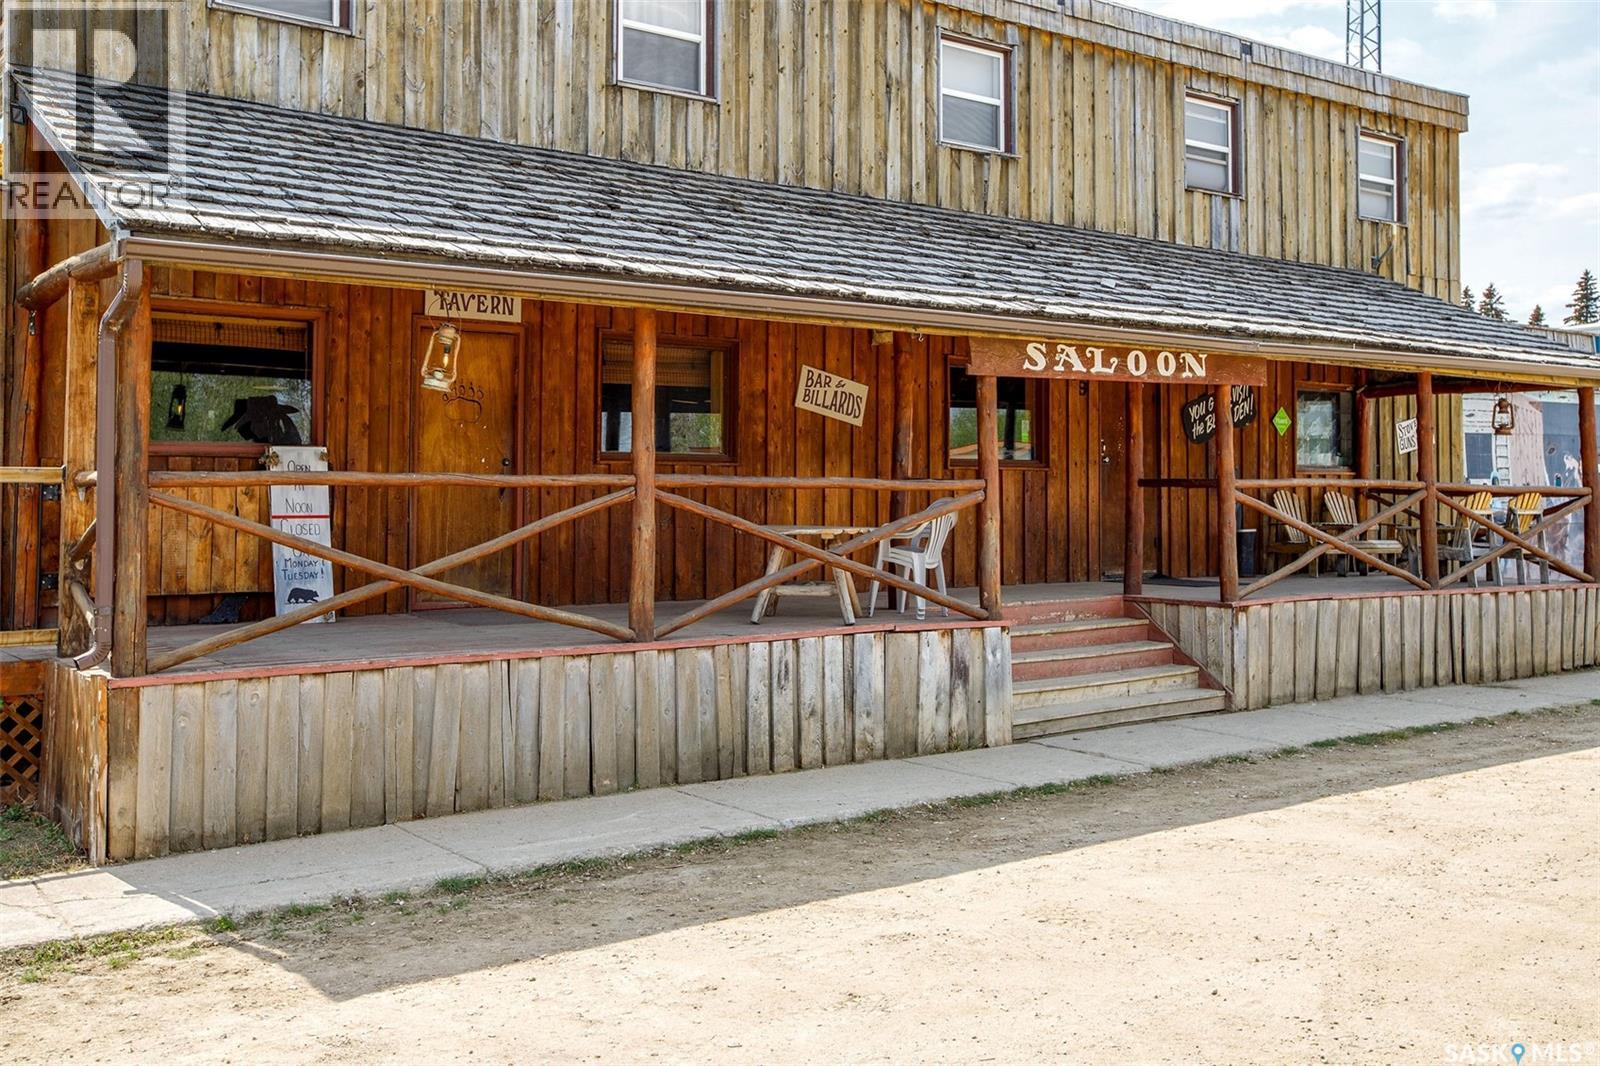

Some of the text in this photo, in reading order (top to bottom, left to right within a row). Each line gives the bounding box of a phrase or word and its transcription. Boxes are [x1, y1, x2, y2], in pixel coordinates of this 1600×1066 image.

[436, 290, 514, 316] TAVERN
[1023, 342, 1208, 378] SALOON
[805, 369, 846, 388] BAR &
[802, 388, 863, 419] BILLARDS
[1188, 400, 1206, 423] YOU
[1192, 420, 1205, 440] the
